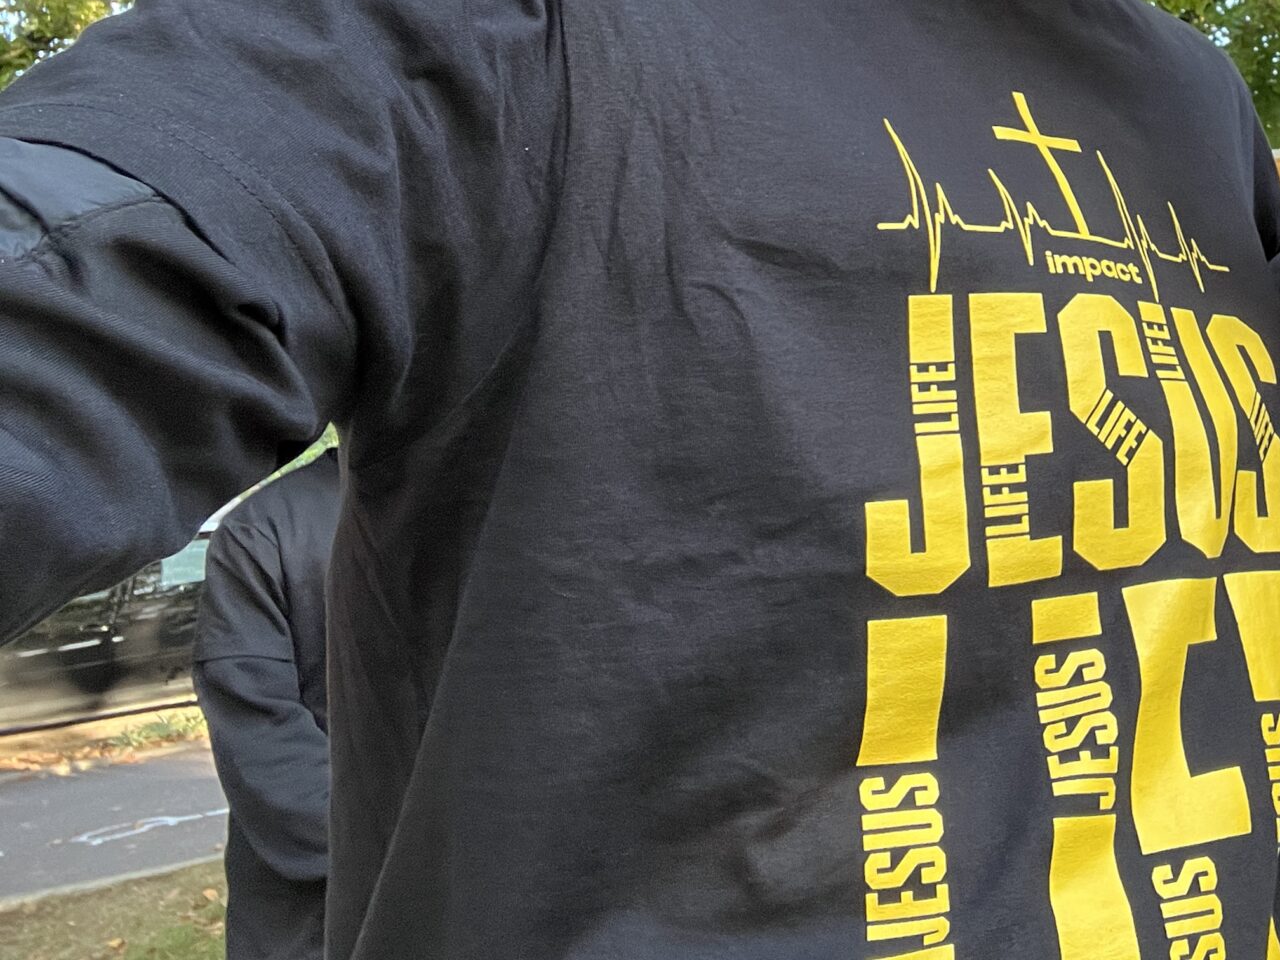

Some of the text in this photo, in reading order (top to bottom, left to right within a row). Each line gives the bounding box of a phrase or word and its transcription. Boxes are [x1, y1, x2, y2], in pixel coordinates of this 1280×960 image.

[1046, 251, 1142, 284] impact
[1142, 322, 1186, 380] LIFE
[909, 362, 959, 435] LIFE
[1086, 390, 1148, 466] LIFE
[1250, 392, 1275, 461] LIFE
[981, 464, 1030, 538] LIFE
[1034, 648, 1119, 810] JESUS
[859, 772, 950, 948] JESUS
